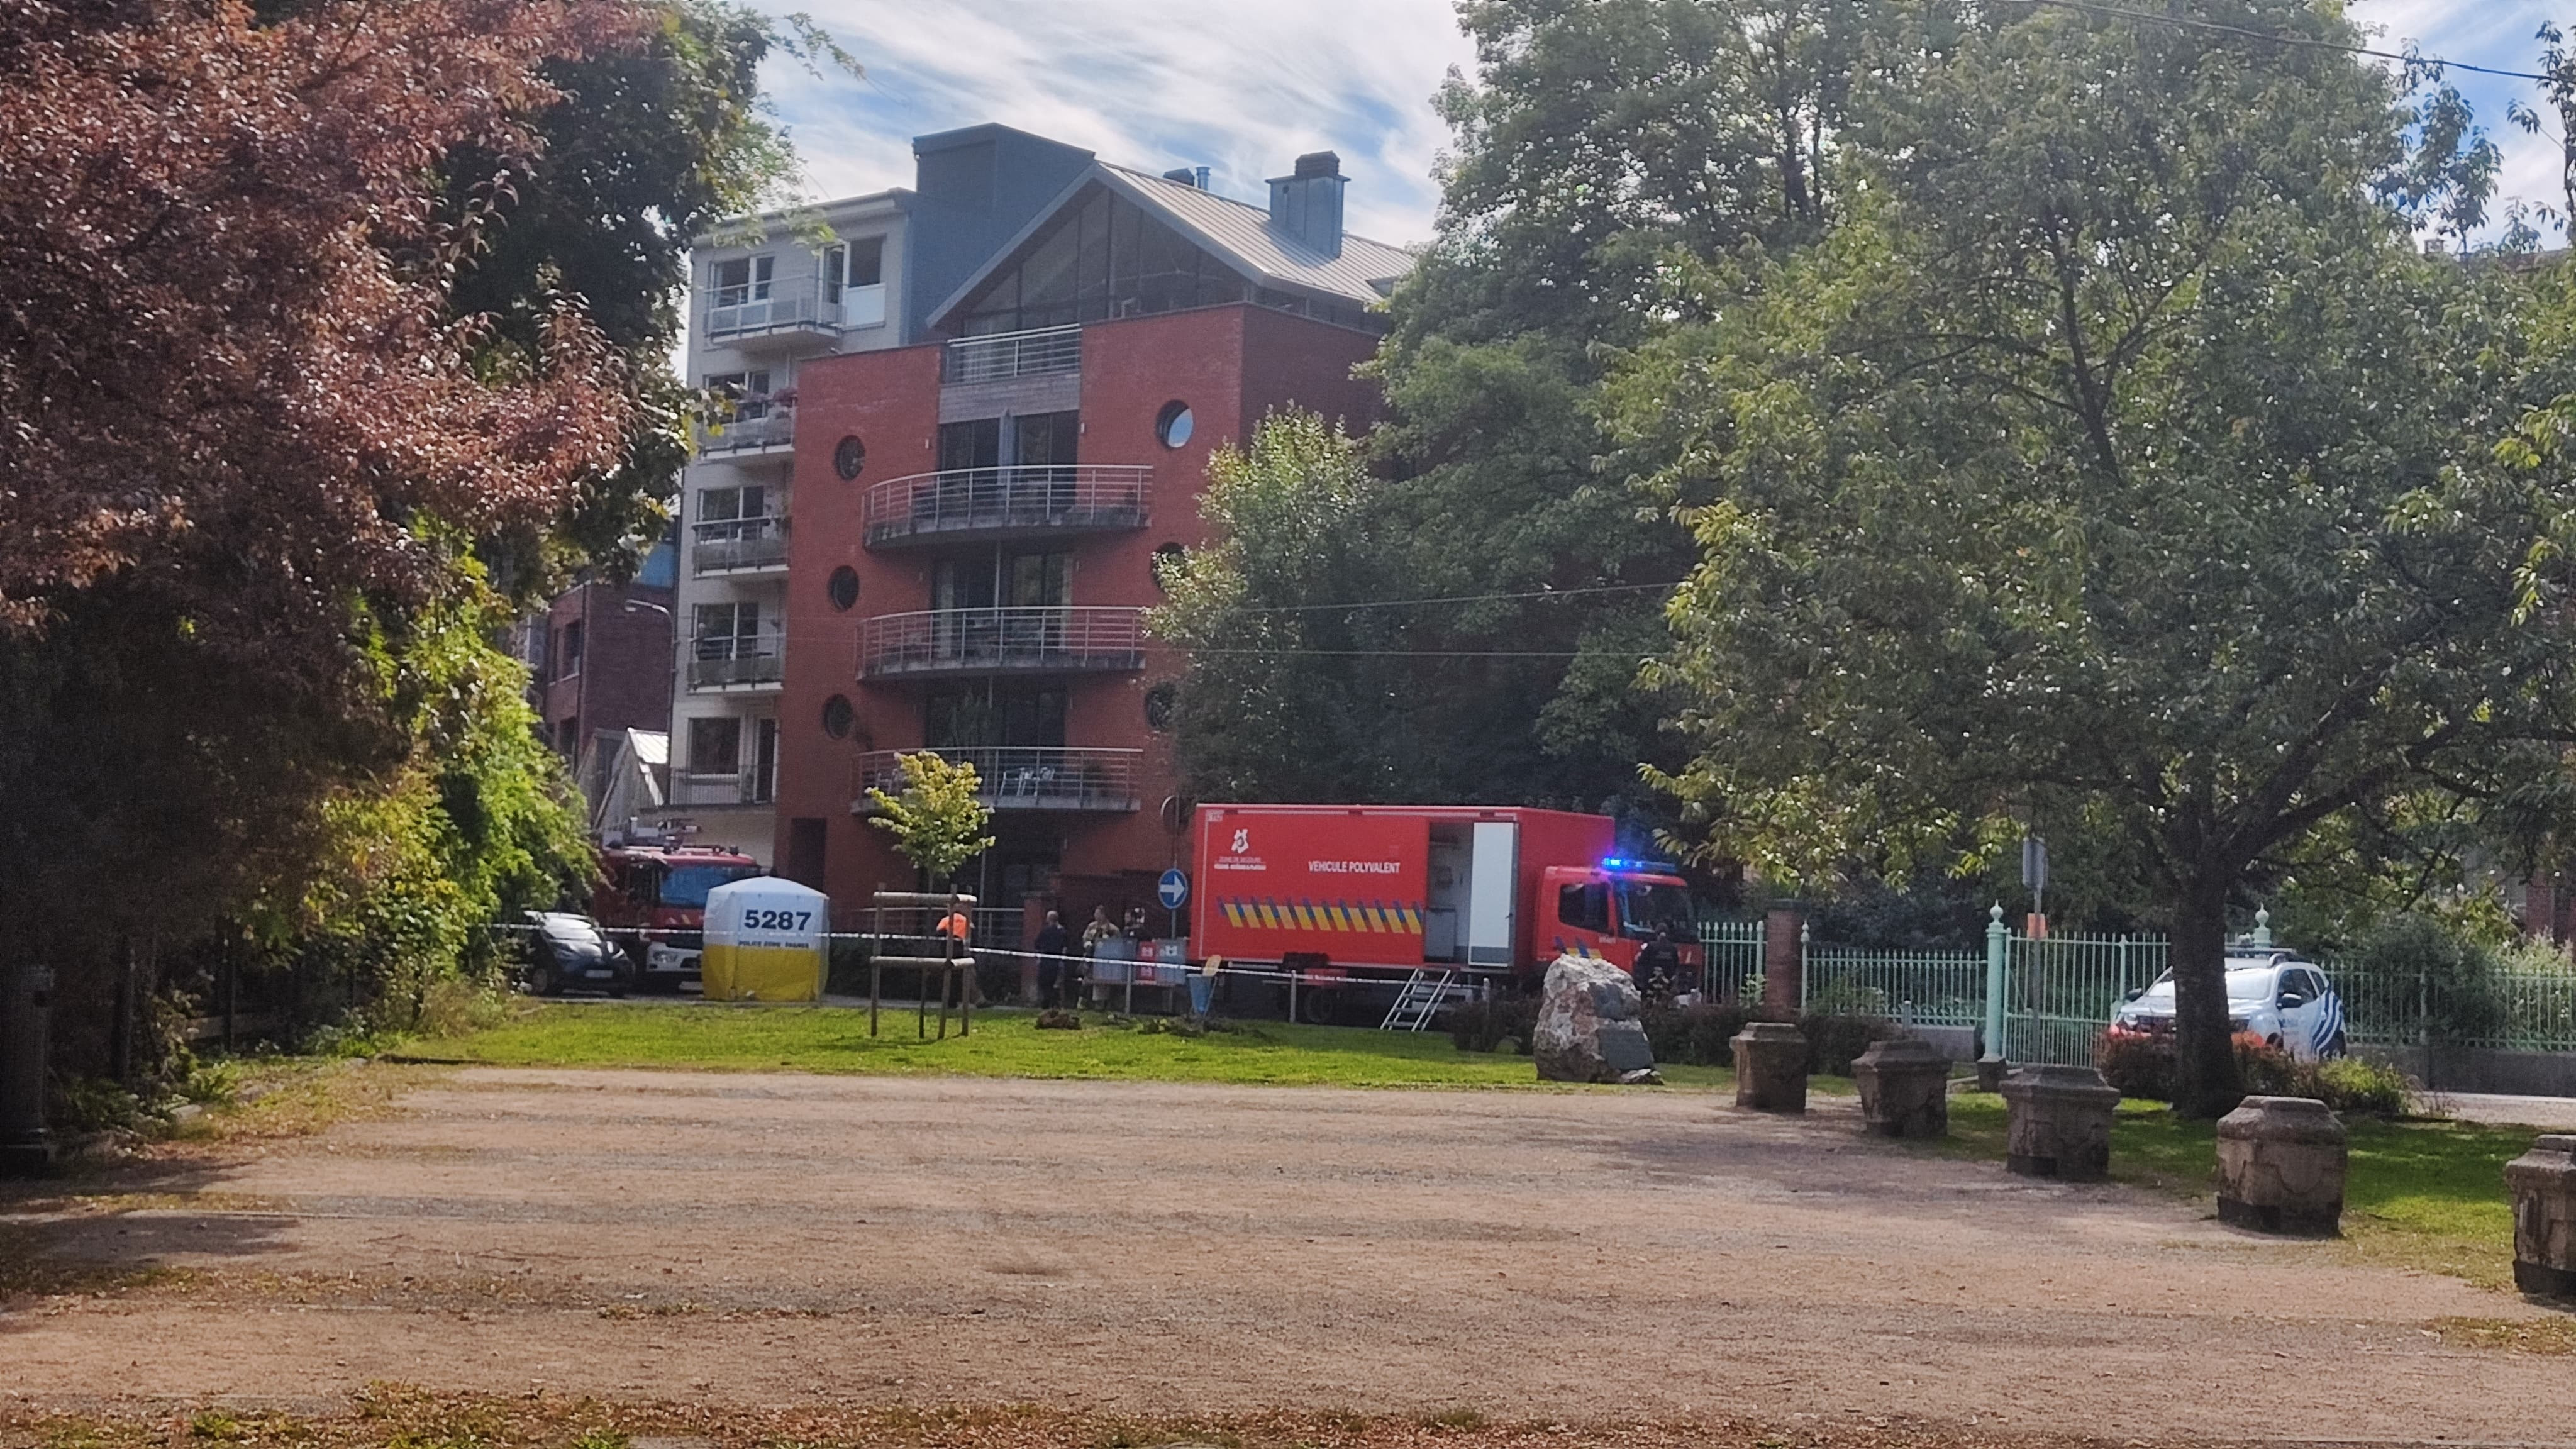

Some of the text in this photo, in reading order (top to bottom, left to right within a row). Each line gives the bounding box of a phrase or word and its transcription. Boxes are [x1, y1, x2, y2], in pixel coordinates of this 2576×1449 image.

[1308, 861, 1401, 873] VEHICULE POLYVALENT
[744, 909, 811, 930] 5287
